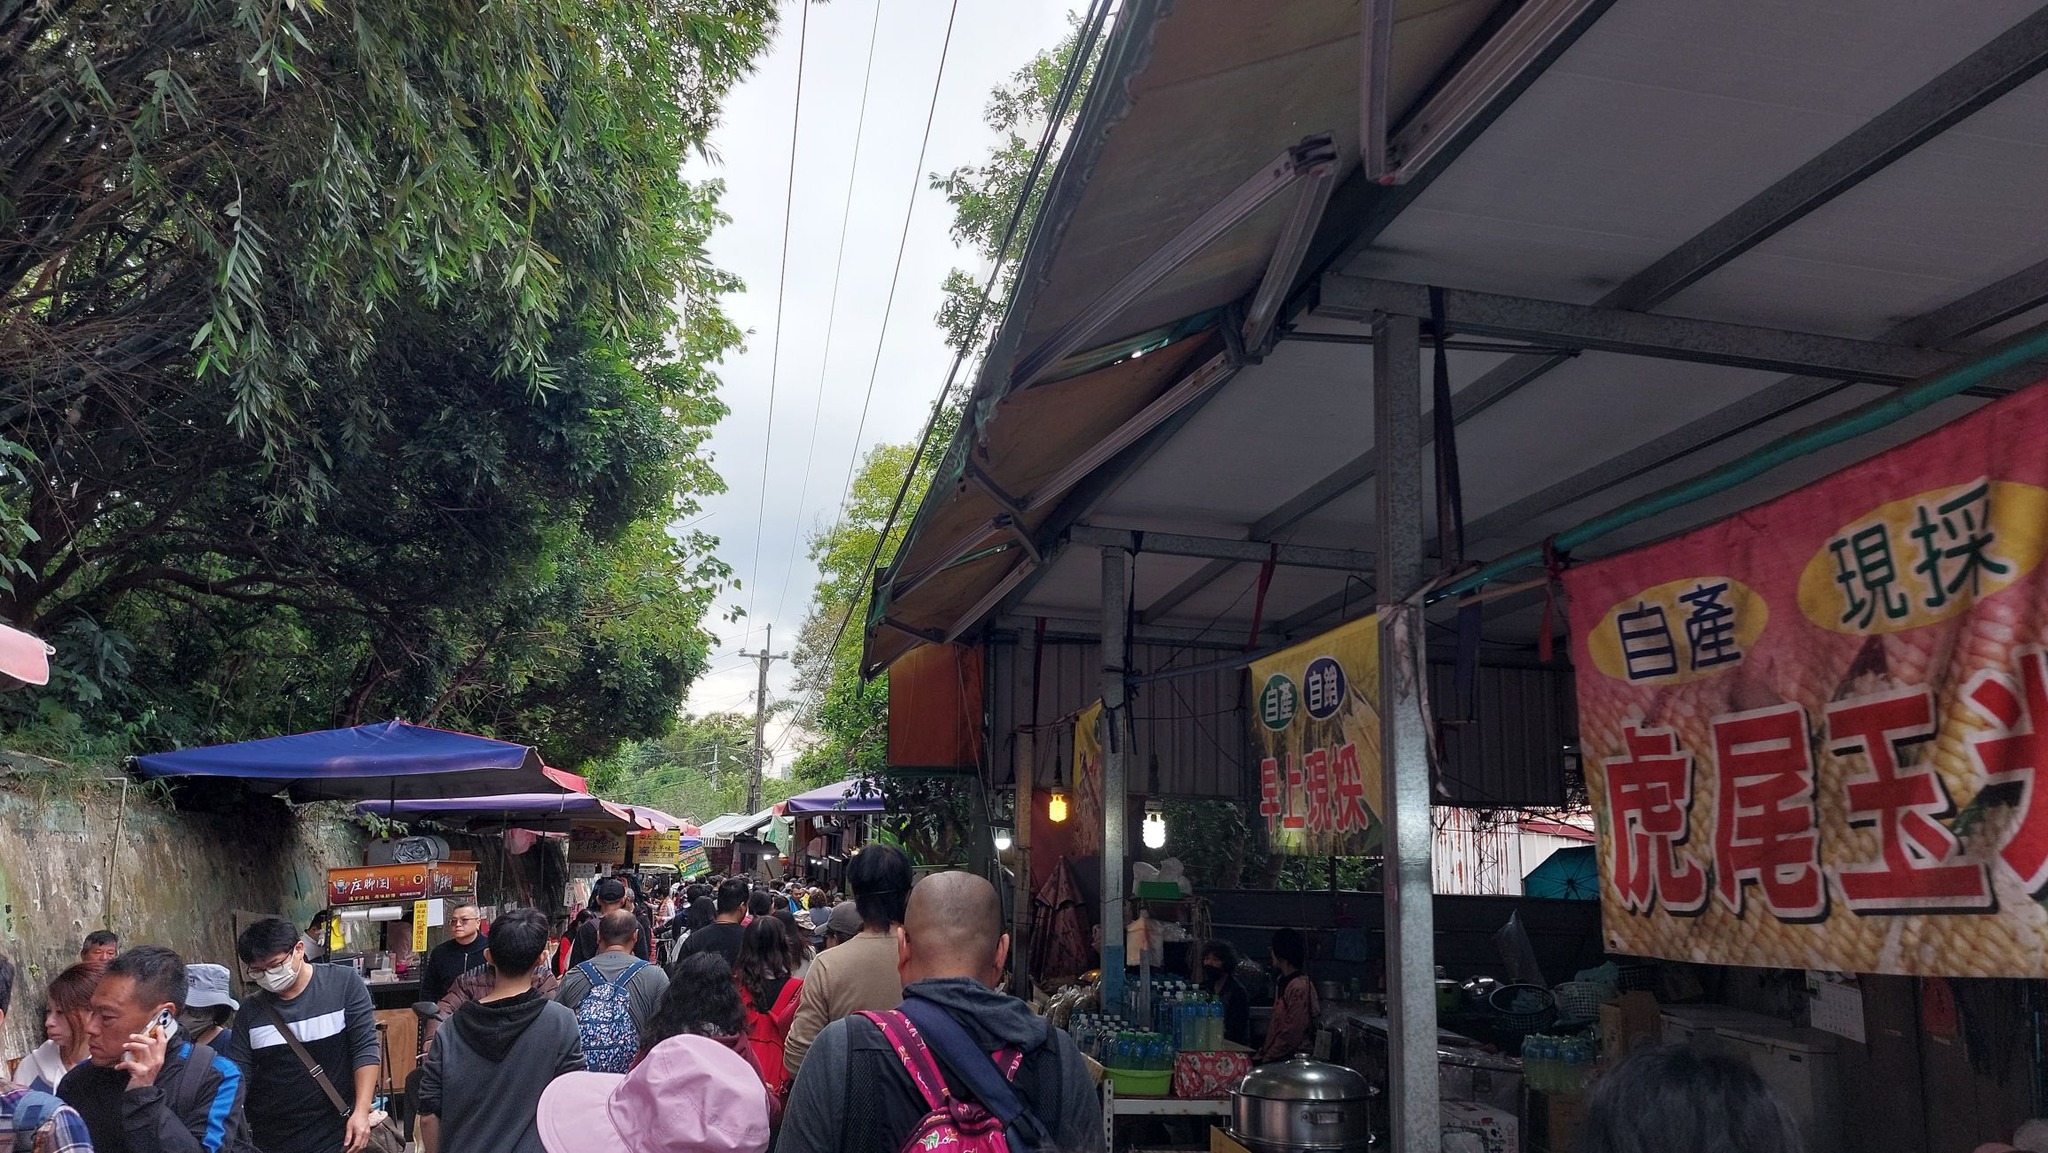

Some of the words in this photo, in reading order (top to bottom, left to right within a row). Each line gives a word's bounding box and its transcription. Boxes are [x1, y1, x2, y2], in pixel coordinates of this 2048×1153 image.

[1828, 478, 2010, 631] 現採
[1616, 581, 1742, 680] 自產
[1264, 681, 1293, 724] 自產
[1308, 663, 1338, 712] 自銷
[1259, 742, 1369, 835] 早上現採
